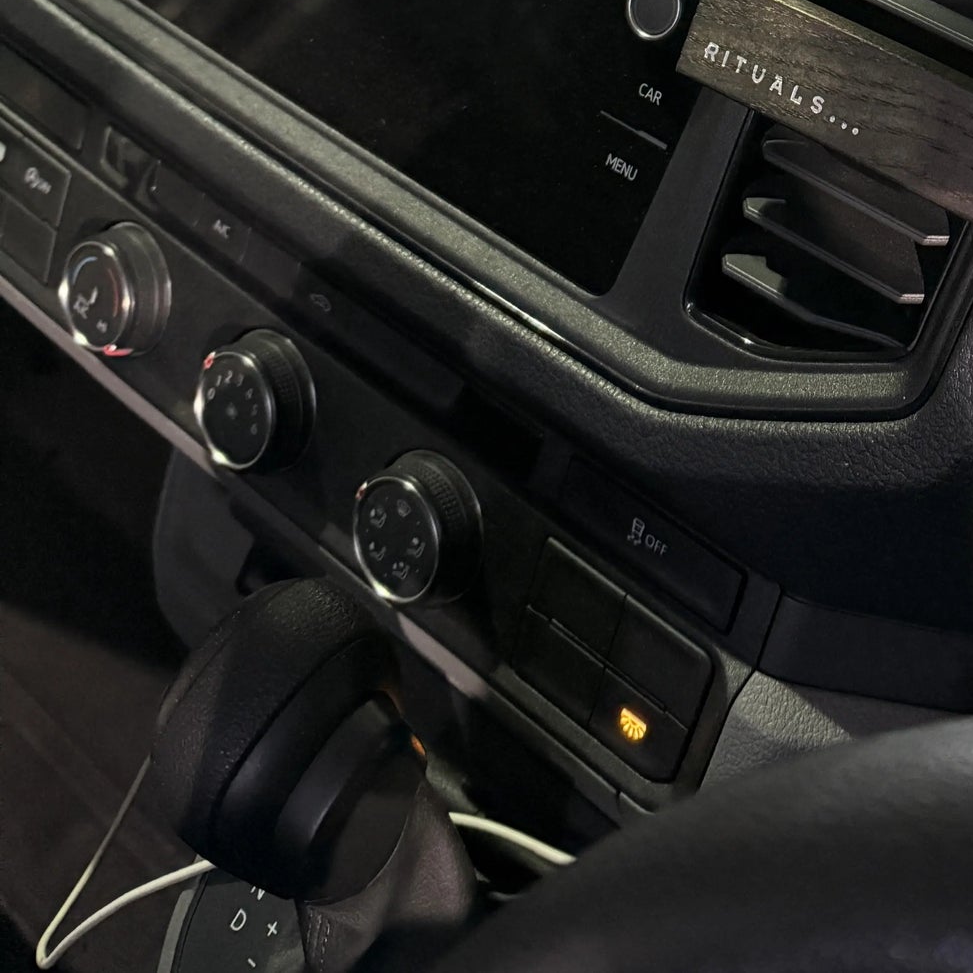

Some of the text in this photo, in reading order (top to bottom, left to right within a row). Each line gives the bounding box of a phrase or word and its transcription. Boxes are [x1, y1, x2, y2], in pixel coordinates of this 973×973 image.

[638, 83, 663, 106] CAR
[605, 152, 638, 181] MENU
[645, 534, 668, 556] OFF
[230, 908, 247, 932] D
